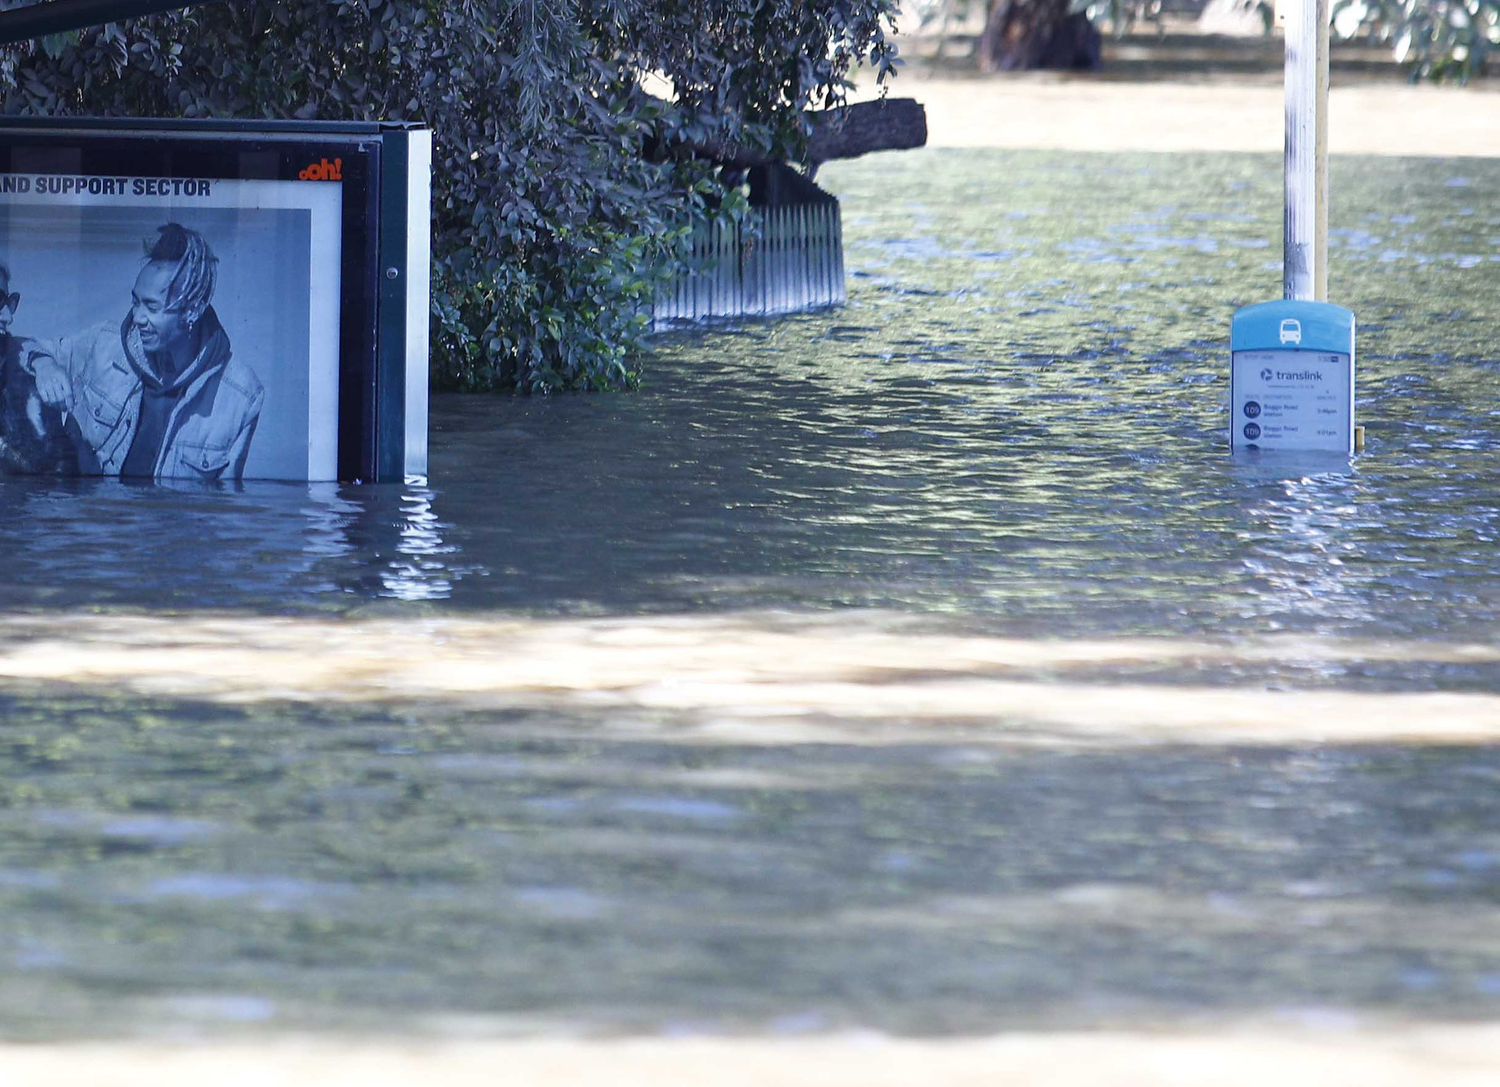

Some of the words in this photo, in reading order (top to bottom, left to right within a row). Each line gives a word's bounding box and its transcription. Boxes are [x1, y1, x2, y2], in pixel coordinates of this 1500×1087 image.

[35, 177, 128, 195] SUPPORT
[132, 178, 211, 196] SECTOR
[1277, 371, 1322, 381] translink
